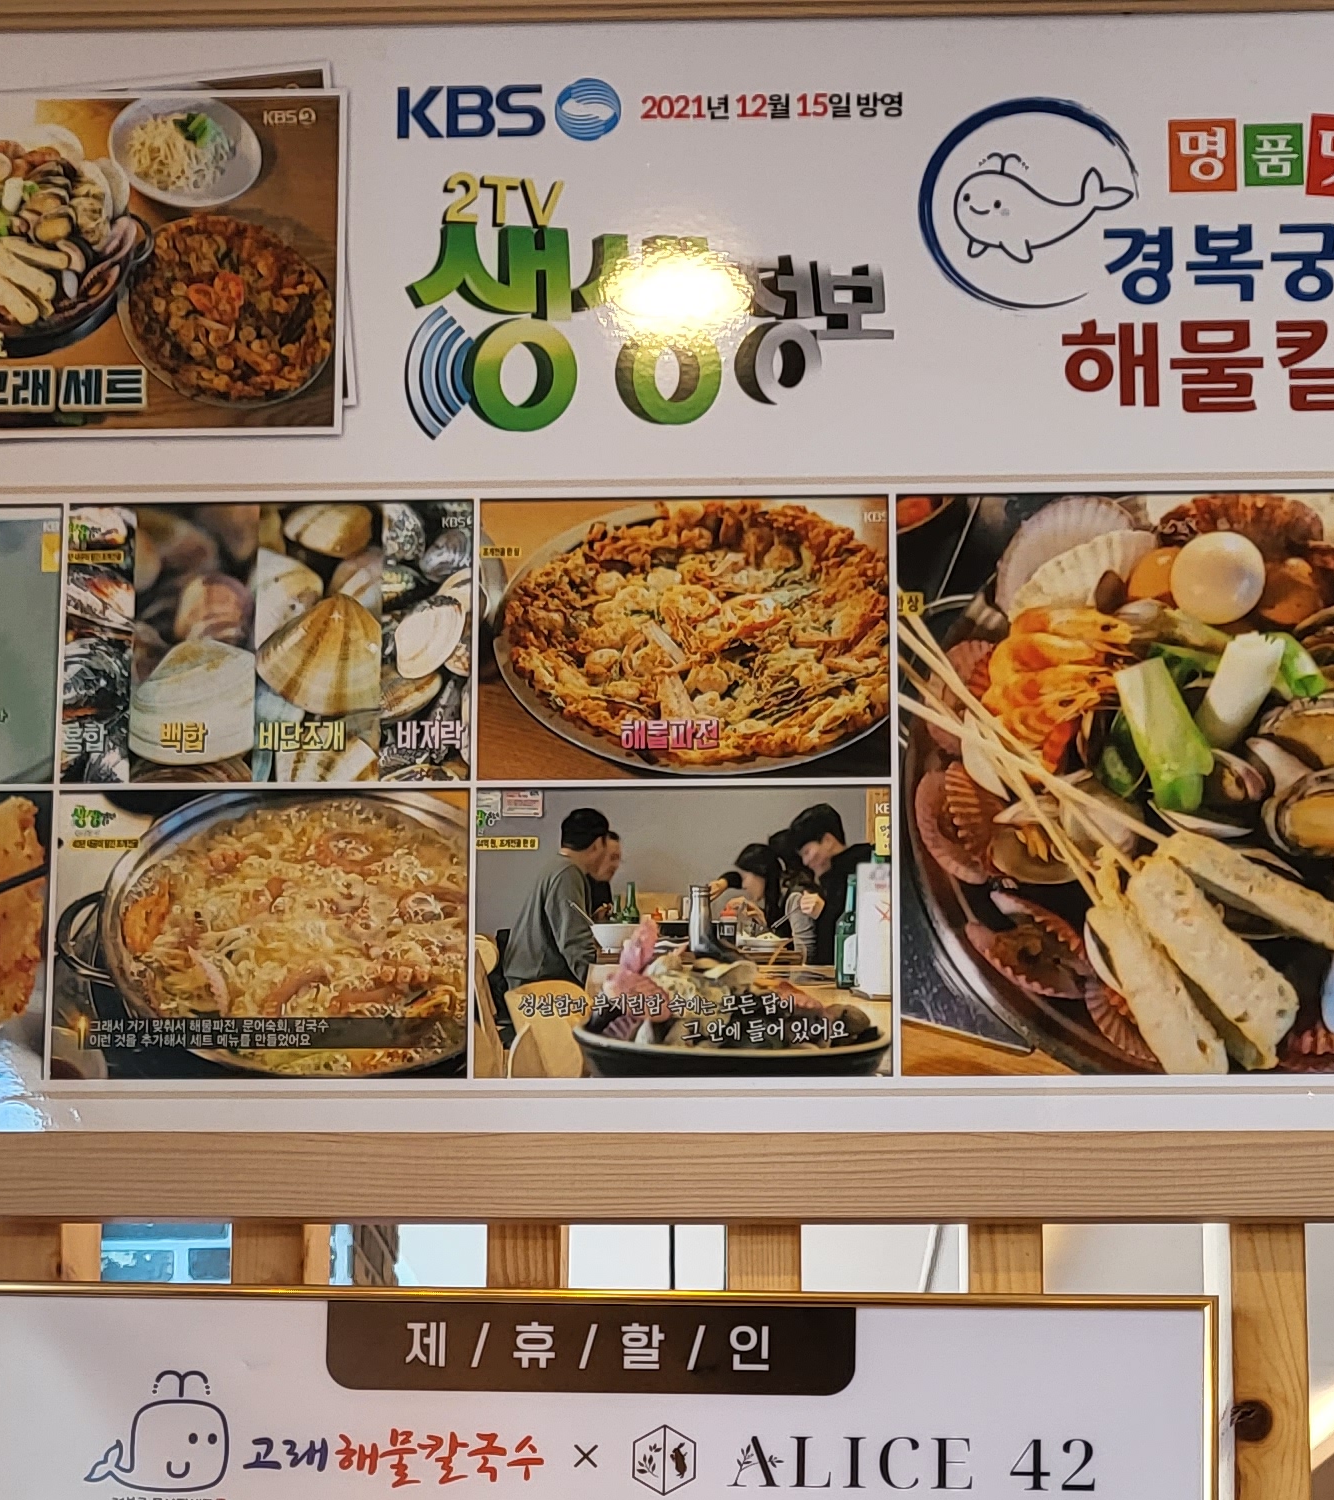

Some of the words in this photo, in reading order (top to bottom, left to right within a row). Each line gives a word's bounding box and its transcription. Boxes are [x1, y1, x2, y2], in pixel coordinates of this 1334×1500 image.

[397, 84, 546, 140] KBS
[640, 93, 731, 121] 2021년
[735, 92, 791, 120] 12월
[796, 91, 852, 119] 15일
[856, 91, 904, 119] 방영
[442, 171, 566, 228] 2TV
[160, 721, 207, 754] 백합
[259, 720, 346, 752] 비단조개
[620, 718, 720, 751] 해물파전
[518, 993, 588, 1017] 성실함과
[592, 993, 663, 1016] 부지런함
[667, 994, 716, 1016] 속에는
[720, 995, 757, 1016] 모든
[761, 994, 795, 1016] 답이
[681, 1020, 702, 1041] 그
[706, 1018, 741, 1042] 안에
[745, 1018, 786, 1043] 들어
[790, 1017, 849, 1044] 있어요
[726, 1434, 973, 1491] ALICE
[1009, 1437, 1098, 1492] 42
